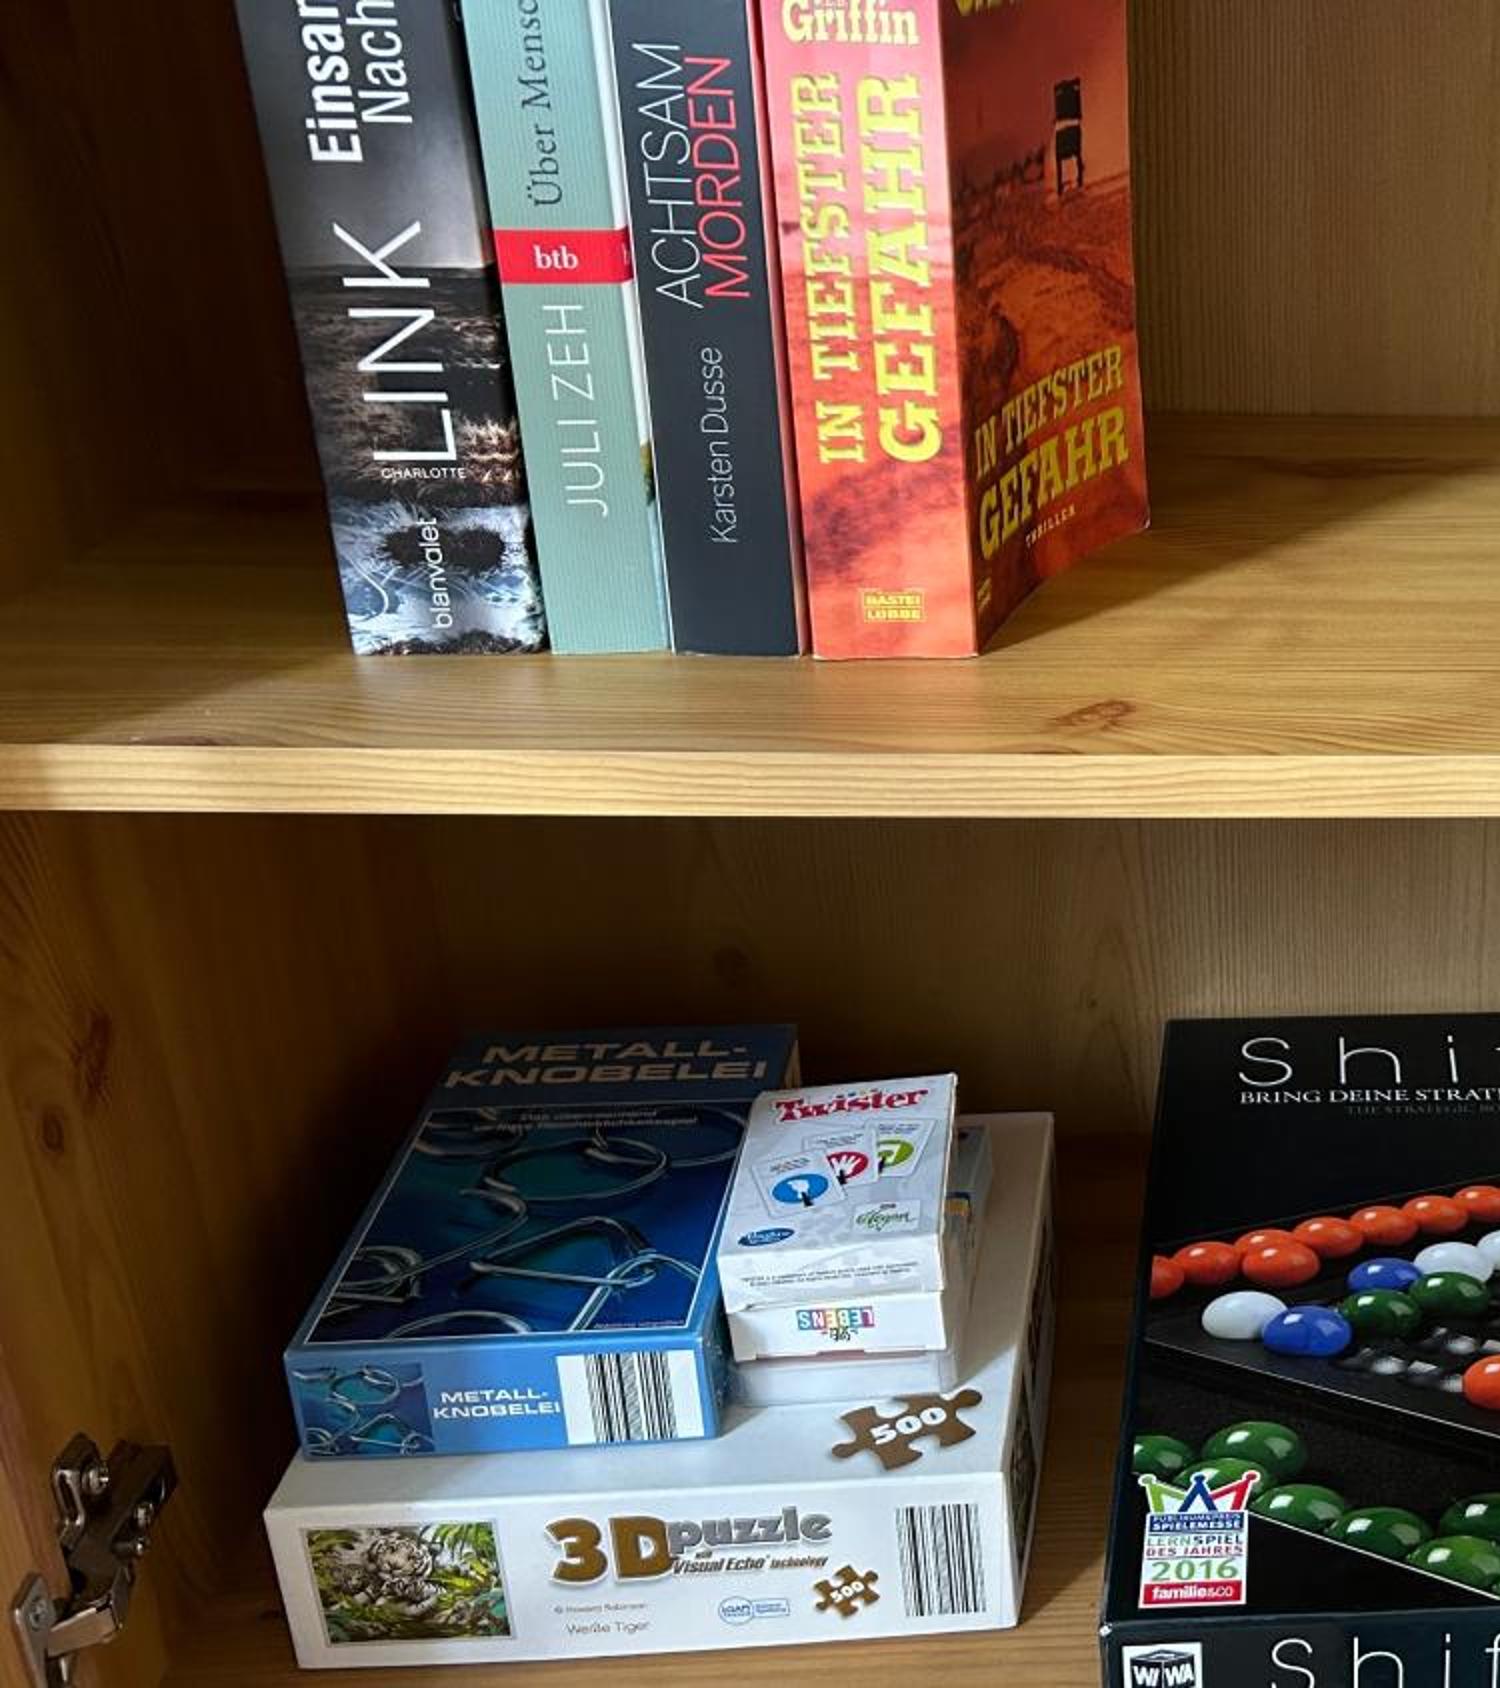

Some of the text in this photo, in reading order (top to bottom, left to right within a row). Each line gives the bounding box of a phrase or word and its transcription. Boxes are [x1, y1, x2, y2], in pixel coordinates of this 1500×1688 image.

[781, 0, 920, 45] Griffin
[526, 124, 564, 207] Über
[632, 43, 704, 309] ACHTSAM
[684, 57, 751, 298] MORDEN
[533, 247, 579, 269] btb
[790, 72, 867, 463] IN TIEFSTER
[856, 72, 943, 463] GEFAHR
[333, 220, 457, 460] LINK
[542, 305, 608, 516] JULI ZEH
[975, 345, 1124, 481] IN TIEFSTER
[702, 346, 737, 544] Karsten Dusse
[381, 466, 467, 480] CHARLOTTE
[979, 405, 1130, 560] GEFAHR
[416, 516, 453, 629] blanvalet
[481, 1040, 748, 1064] METALL-
[444, 1060, 768, 1089] KNOBELEI
[775, 1088, 929, 1122] Twister
[1240, 1090, 1322, 1105] BRING
[1330, 1089, 1411, 1103] DEINE
[796, 1306, 875, 1330] LEBENS
[433, 1402, 561, 1420] KNOBELEI
[440, 1388, 549, 1404] METALL-
[870, 1406, 947, 1445] 500
[1147, 1534, 1243, 1546] LERNSPIEL
[1152, 1520, 1241, 1531] SPIELEMESSE
[545, 1505, 833, 1586] 3D puzzle
[1146, 1545, 1244, 1557] DES JAHRES
[673, 1557, 725, 1574] Visual
[1151, 1557, 1239, 1582] 2016
[829, 1580, 865, 1603] 500
